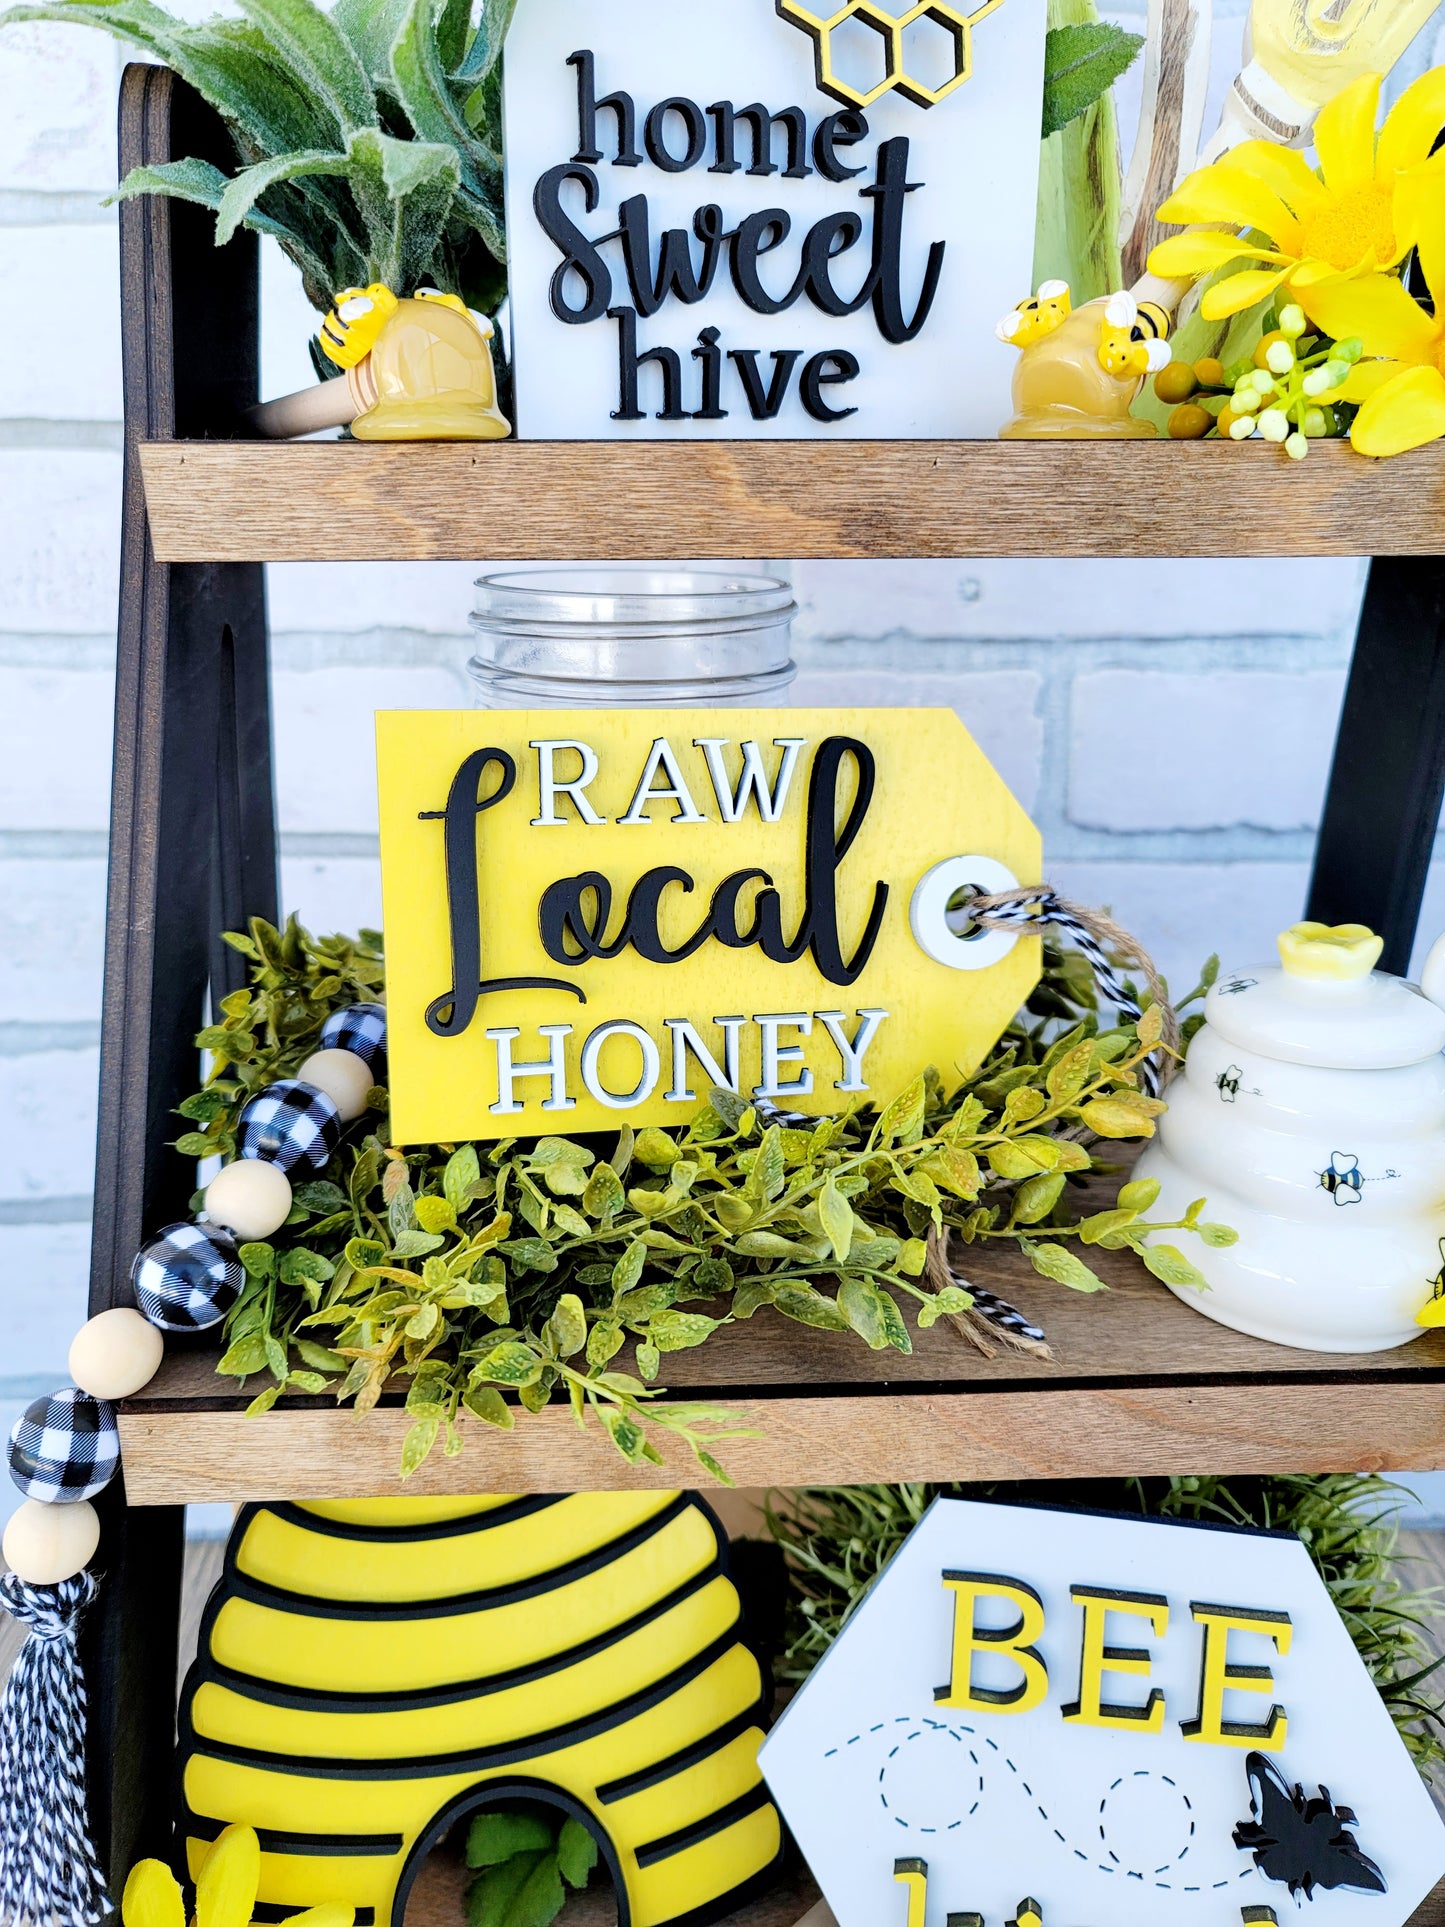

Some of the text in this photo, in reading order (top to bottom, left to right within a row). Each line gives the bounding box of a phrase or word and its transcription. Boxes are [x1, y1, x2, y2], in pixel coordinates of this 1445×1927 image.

[565, 49, 870, 182] home
[606, 306, 861, 423] hive
[528, 736, 809, 826] RAW
[418, 735, 890, 1037] Local
[484, 1007, 890, 1114] HONEY
[932, 1568, 1293, 1753] BEE
